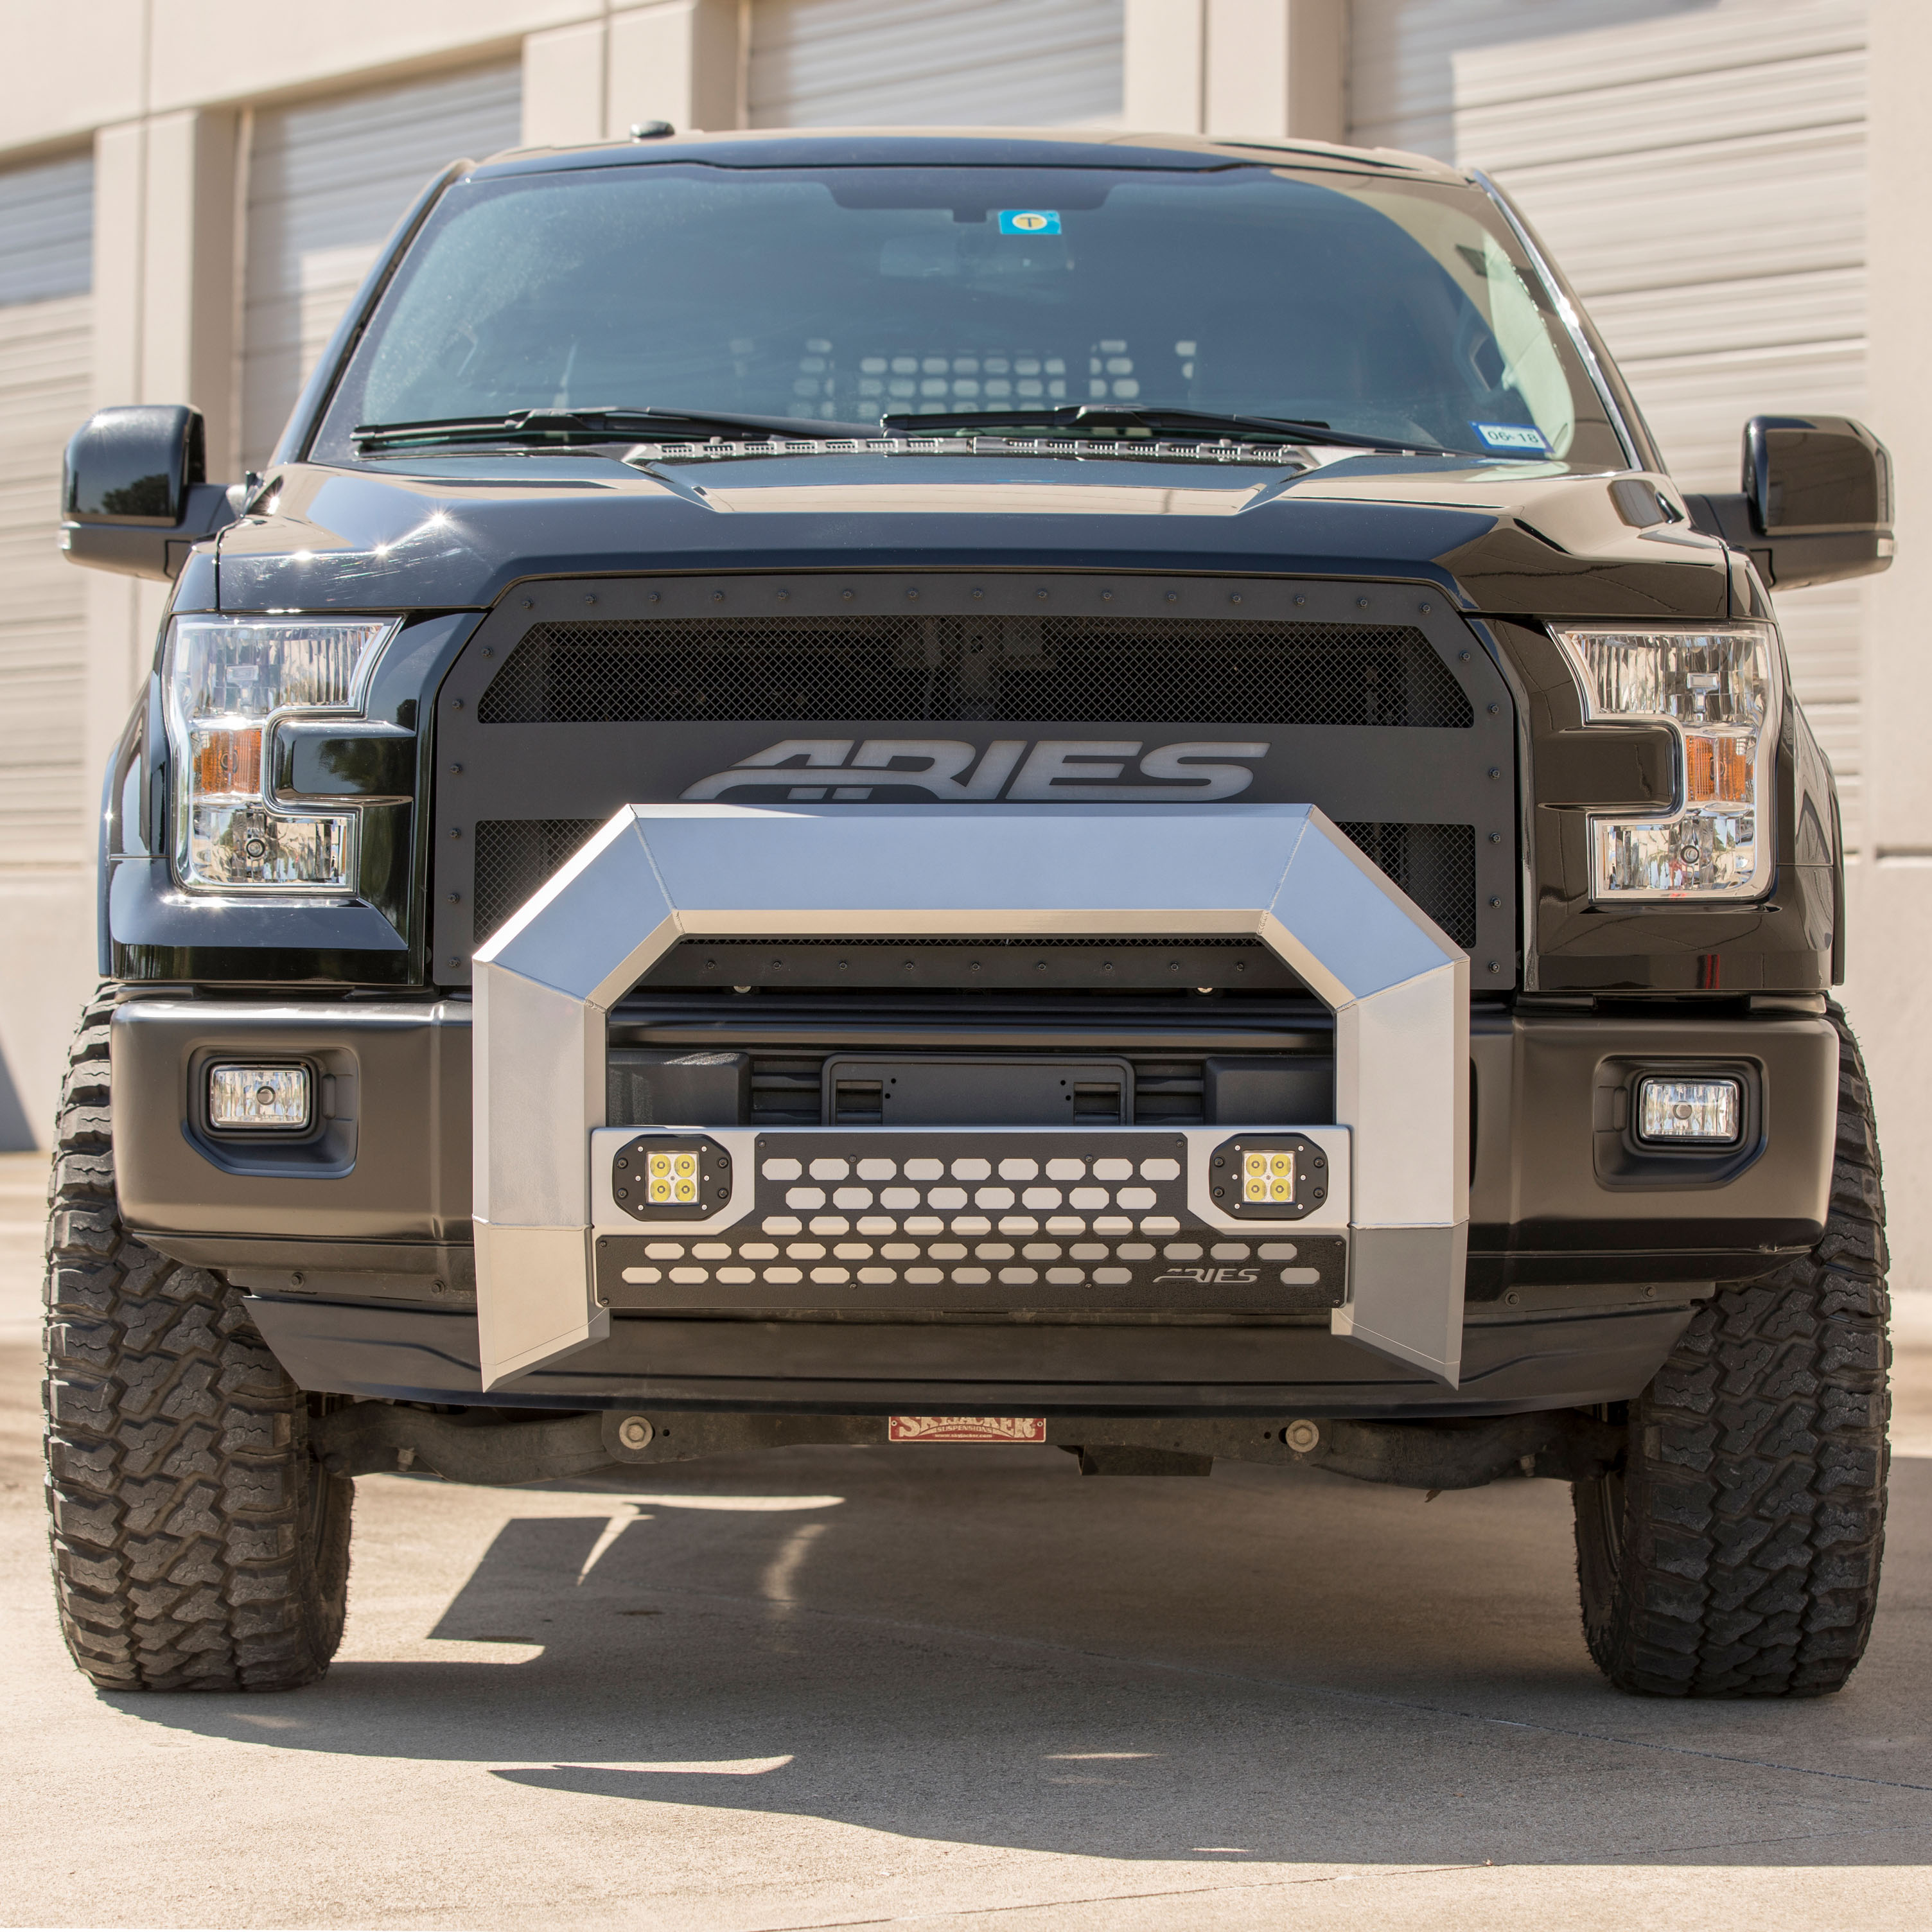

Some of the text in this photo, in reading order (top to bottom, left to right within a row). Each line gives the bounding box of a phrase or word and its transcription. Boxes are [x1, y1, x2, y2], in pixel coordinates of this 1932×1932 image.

[1019, 216, 1040, 228] T
[678, 739, 1272, 801] ARIES
[1152, 1268, 1261, 1283] ARIES
[937, 1424, 993, 1434] SUSPENSIONS
